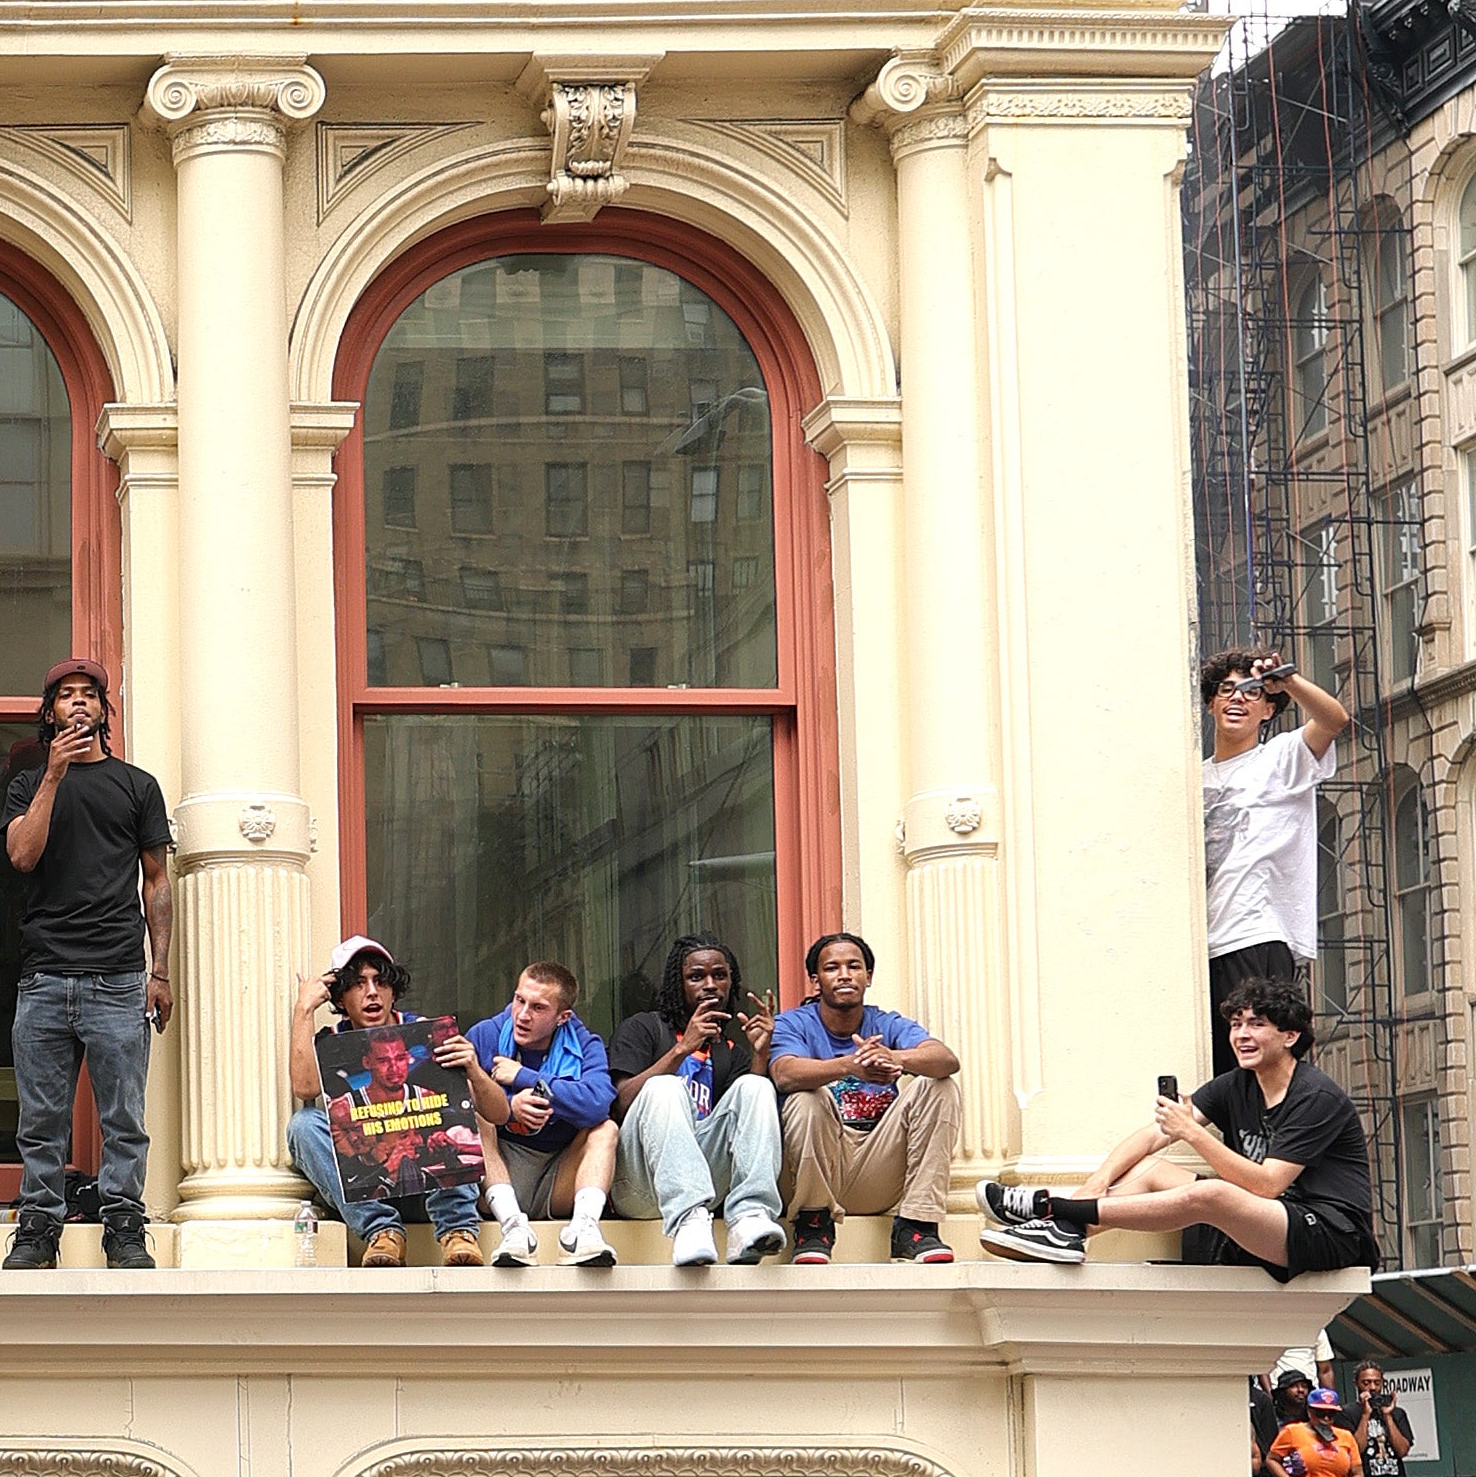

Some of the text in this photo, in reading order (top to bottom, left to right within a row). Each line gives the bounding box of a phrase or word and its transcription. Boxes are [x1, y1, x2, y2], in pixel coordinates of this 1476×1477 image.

[350, 1093, 449, 1122] REFUSING TO HIDE
[362, 1112, 443, 1136] HIS EMOTIONS
[1382, 1375, 1431, 1394] ROADWAY
